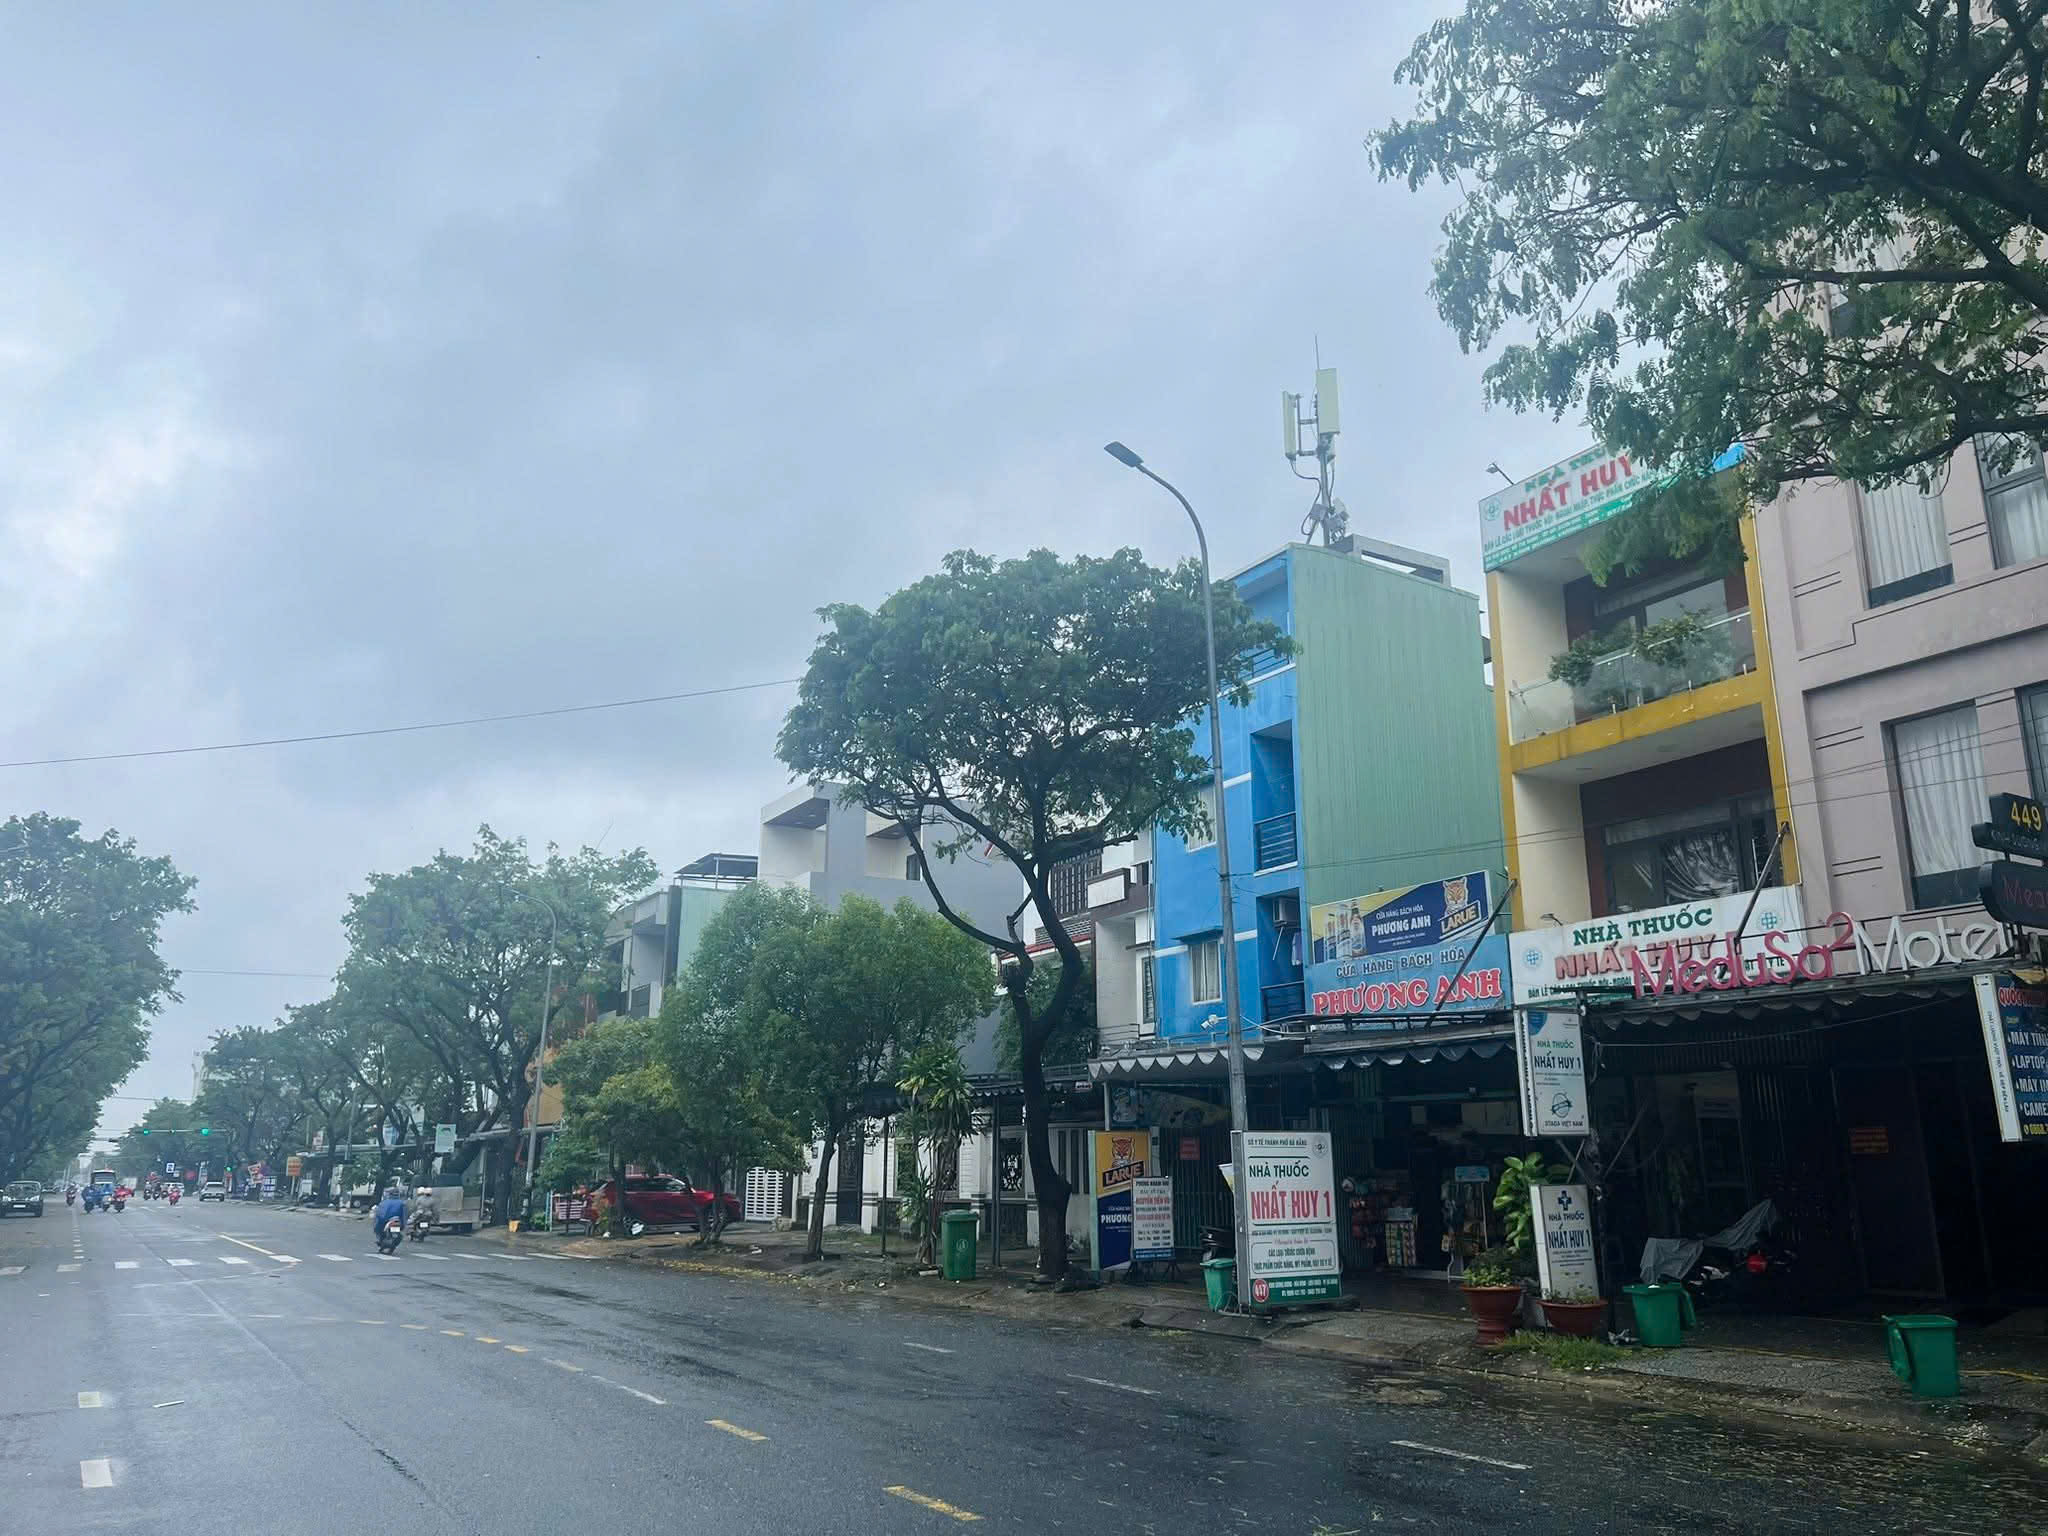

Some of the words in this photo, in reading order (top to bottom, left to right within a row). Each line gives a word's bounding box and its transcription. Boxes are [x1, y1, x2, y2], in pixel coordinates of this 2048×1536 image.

[1504, 479, 1571, 531] NHẤT
[2010, 800, 2042, 832] 449
[1371, 918, 1409, 937] PHƯƠNG
[1410, 914, 1431, 930] ANH
[1440, 904, 1478, 934] LARUE
[1573, 920, 1622, 946] NHÀ
[1628, 904, 1713, 937] THUỐC
[1400, 951, 1432, 968] BÁCH
[1312, 978, 1429, 1016] PHƯƠNG
[1433, 967, 1503, 1005] ANH
[2010, 1029, 2029, 1046] MÁY
[1534, 1051, 1555, 1069] NHẤT
[1558, 1056, 1575, 1069] HUY
[1576, 1056, 1581, 1070] 1
[2015, 1055, 2045, 1070] LAPTOP
[2018, 1076, 2037, 1093] MÁY
[1105, 1164, 1142, 1185] LARUE
[1249, 1161, 1271, 1178] NHÀ
[1273, 1159, 1309, 1178] THUỐC
[1250, 1180, 1287, 1220] NHẤT
[1291, 1190, 1319, 1218] HUY
[1323, 1190, 1331, 1217] 1
[1569, 1229, 1585, 1248] HUY
